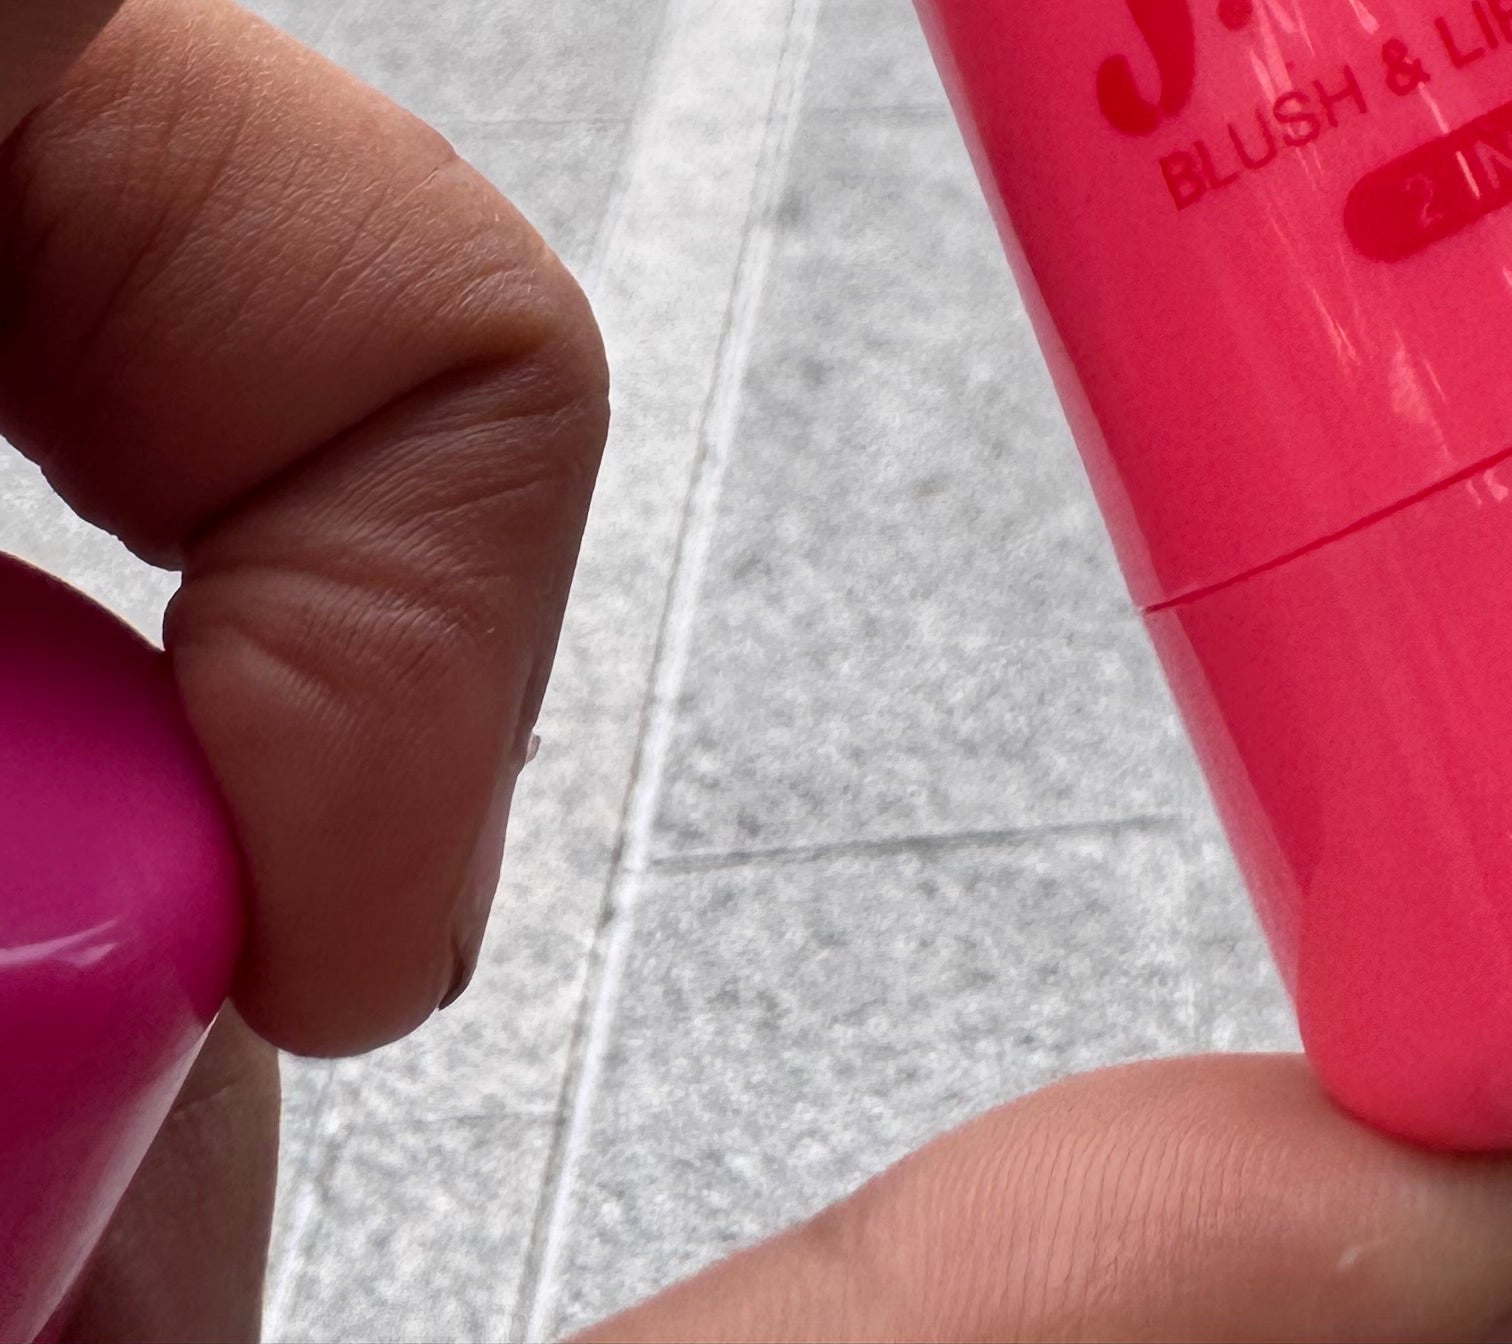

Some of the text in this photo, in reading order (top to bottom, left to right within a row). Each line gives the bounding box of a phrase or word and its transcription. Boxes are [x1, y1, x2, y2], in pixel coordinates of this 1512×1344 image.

[1159, 65, 1368, 210] BLUSH
[1381, 38, 1431, 96] &
[1402, 174, 1443, 228] 2
